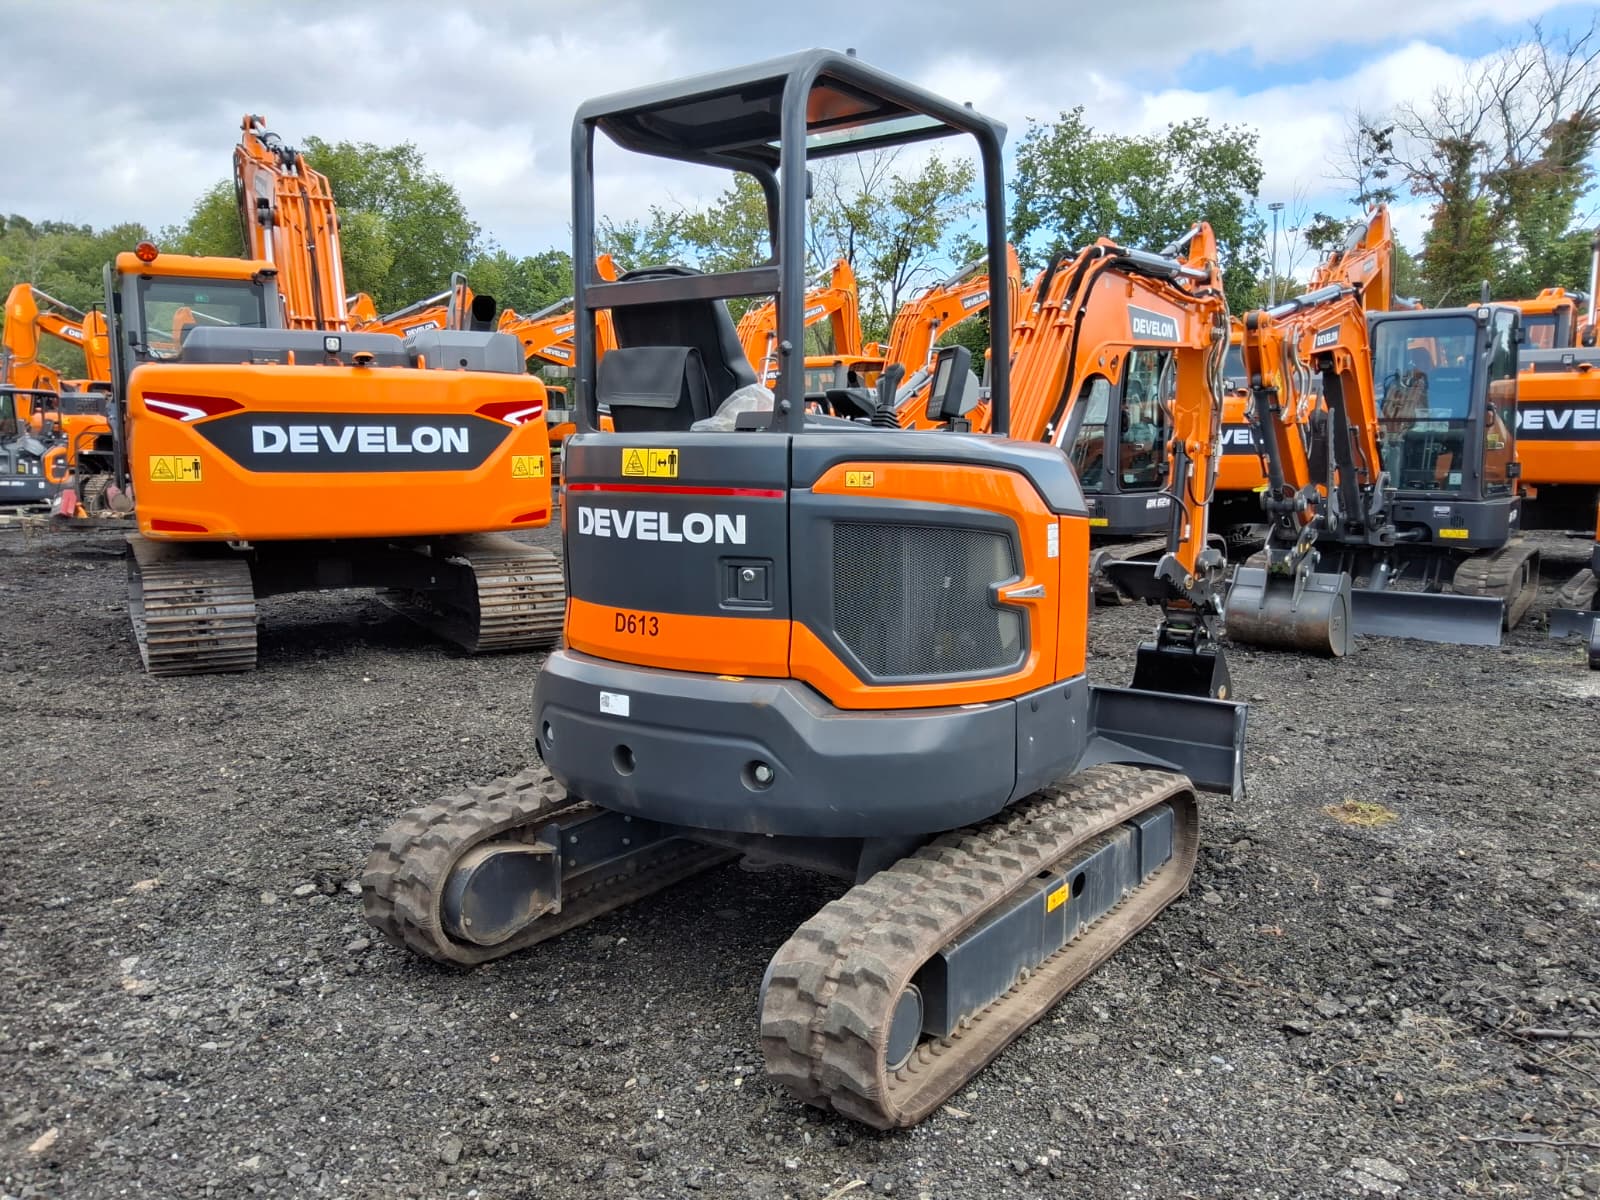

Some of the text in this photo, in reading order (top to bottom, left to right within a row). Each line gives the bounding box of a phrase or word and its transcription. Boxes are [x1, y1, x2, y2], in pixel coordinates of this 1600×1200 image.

[1133, 317, 1174, 338] DEVELON
[1316, 330, 1338, 347] DEVELON
[1516, 409, 1600, 430] EVE
[251, 425, 469, 453] DEVELON
[578, 506, 746, 544] DEVELON
[615, 612, 659, 637] D613
